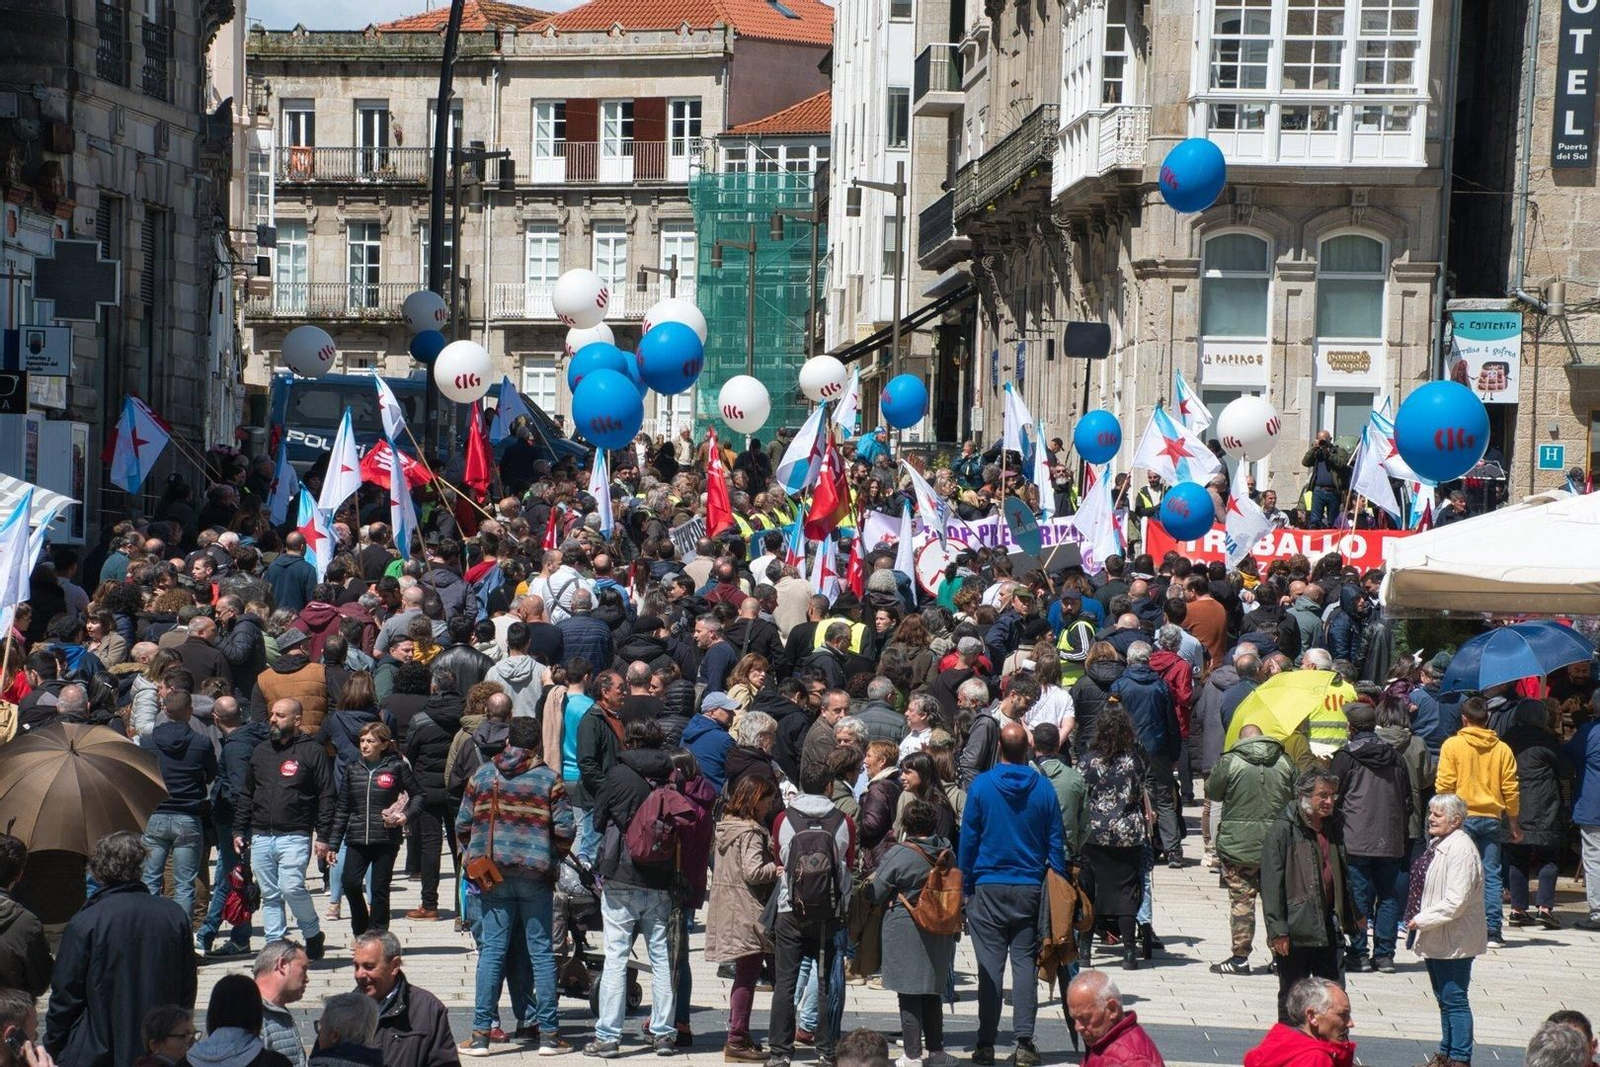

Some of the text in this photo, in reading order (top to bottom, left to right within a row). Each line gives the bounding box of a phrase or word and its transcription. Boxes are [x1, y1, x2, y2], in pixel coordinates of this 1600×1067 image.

[1558, 142, 1588, 151] Puerta
[1556, 153, 1571, 161] del
[1470, 321, 1517, 330] CONTENTA
[1215, 354, 1255, 365] PAPERO
[455, 373, 480, 389] CIG
[820, 382, 842, 397] CIG
[723, 404, 744, 419] CIG
[1223, 436, 1242, 449] CIG
[1433, 426, 1475, 451] CIG
[1545, 447, 1558, 461] H
[1186, 530, 1367, 559] TRBALLO
